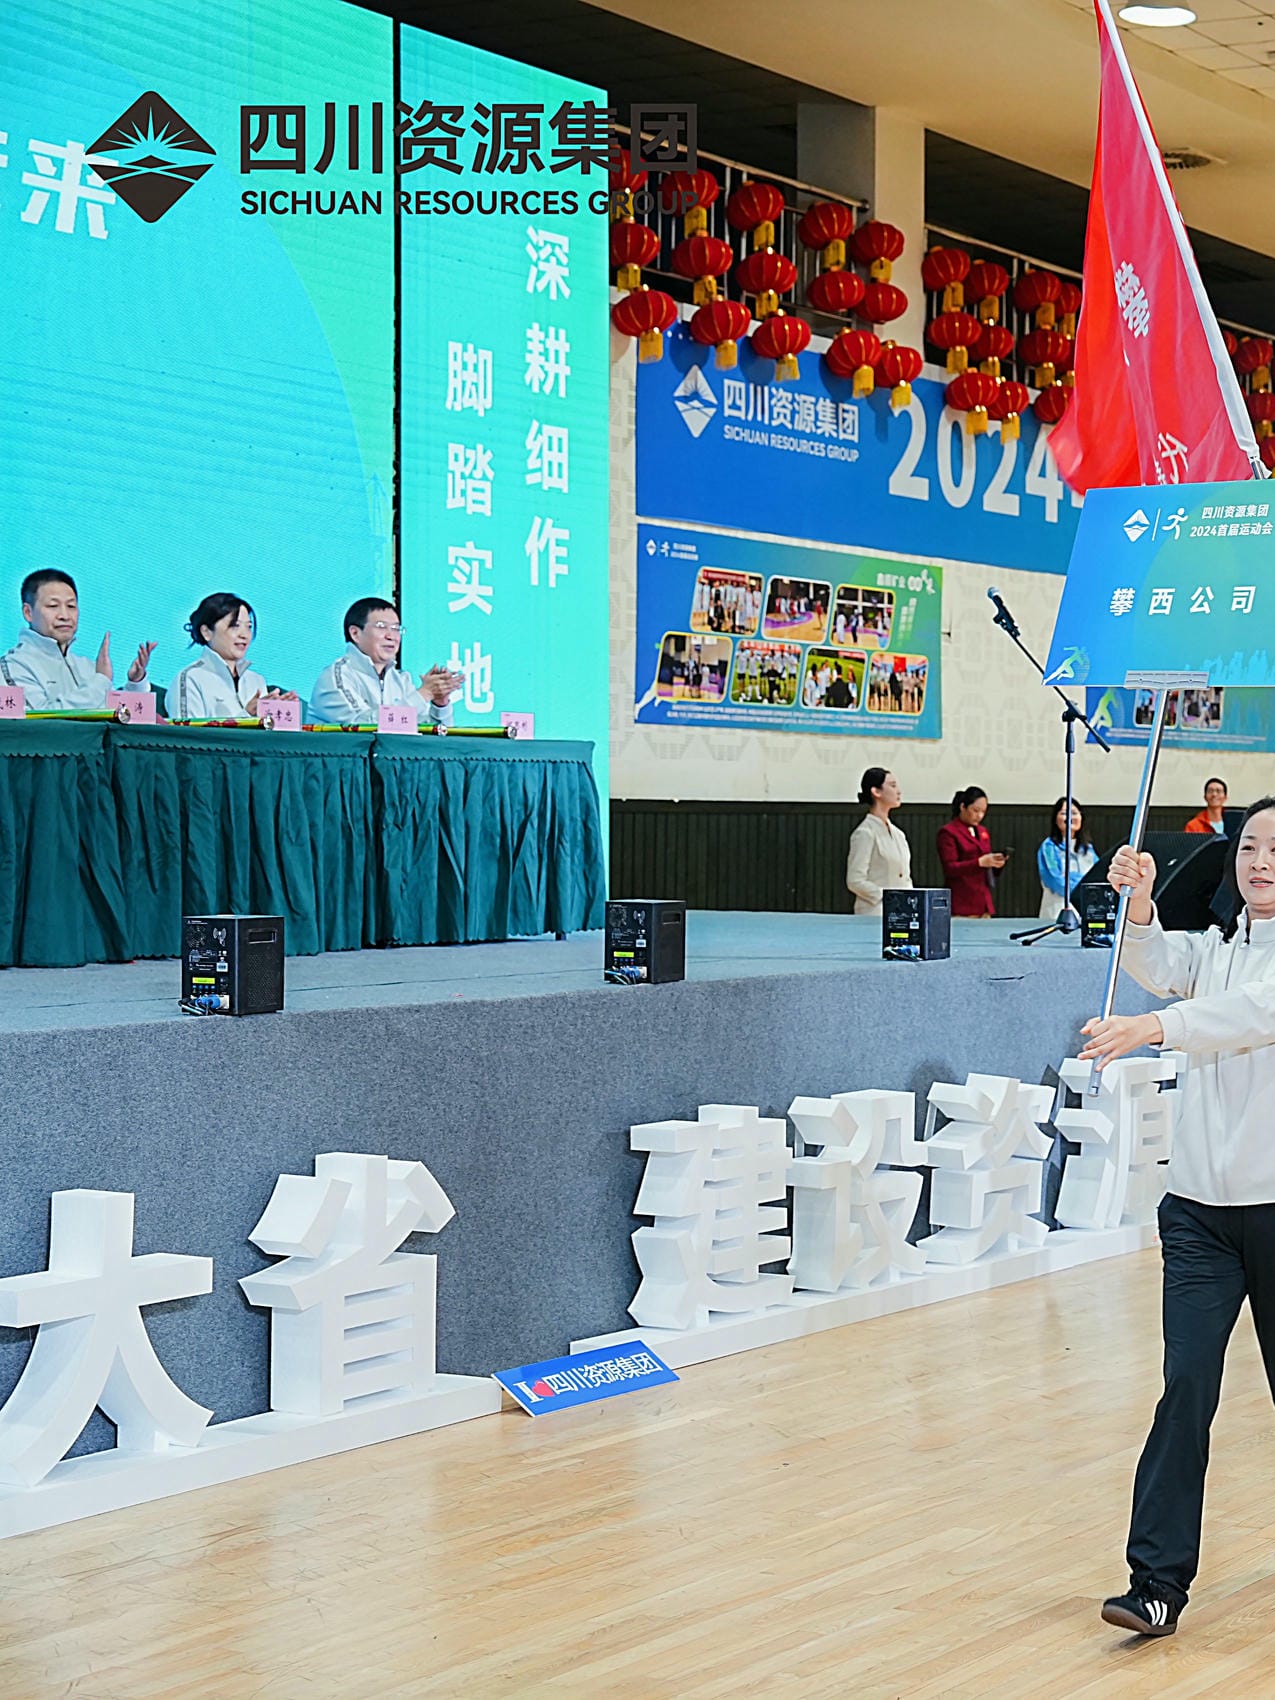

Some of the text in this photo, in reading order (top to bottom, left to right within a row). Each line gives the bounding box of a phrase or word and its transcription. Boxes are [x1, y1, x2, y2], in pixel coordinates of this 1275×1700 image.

[524, 226, 572, 588] 深耕细作
[723, 379, 860, 443] 四川资源集团
[723, 424, 860, 463] SICHUAN RESOURCES GROUP
[445, 340, 495, 714] 脚踏实地
[1189, 522, 1274, 538] 2024首届运动会
[1201, 504, 1270, 519] 四川资源集团
[1109, 585, 1257, 616] 攀西公司
[0, 1151, 455, 1487] 大省
[544, 1351, 663, 1395] 四川资源集团
